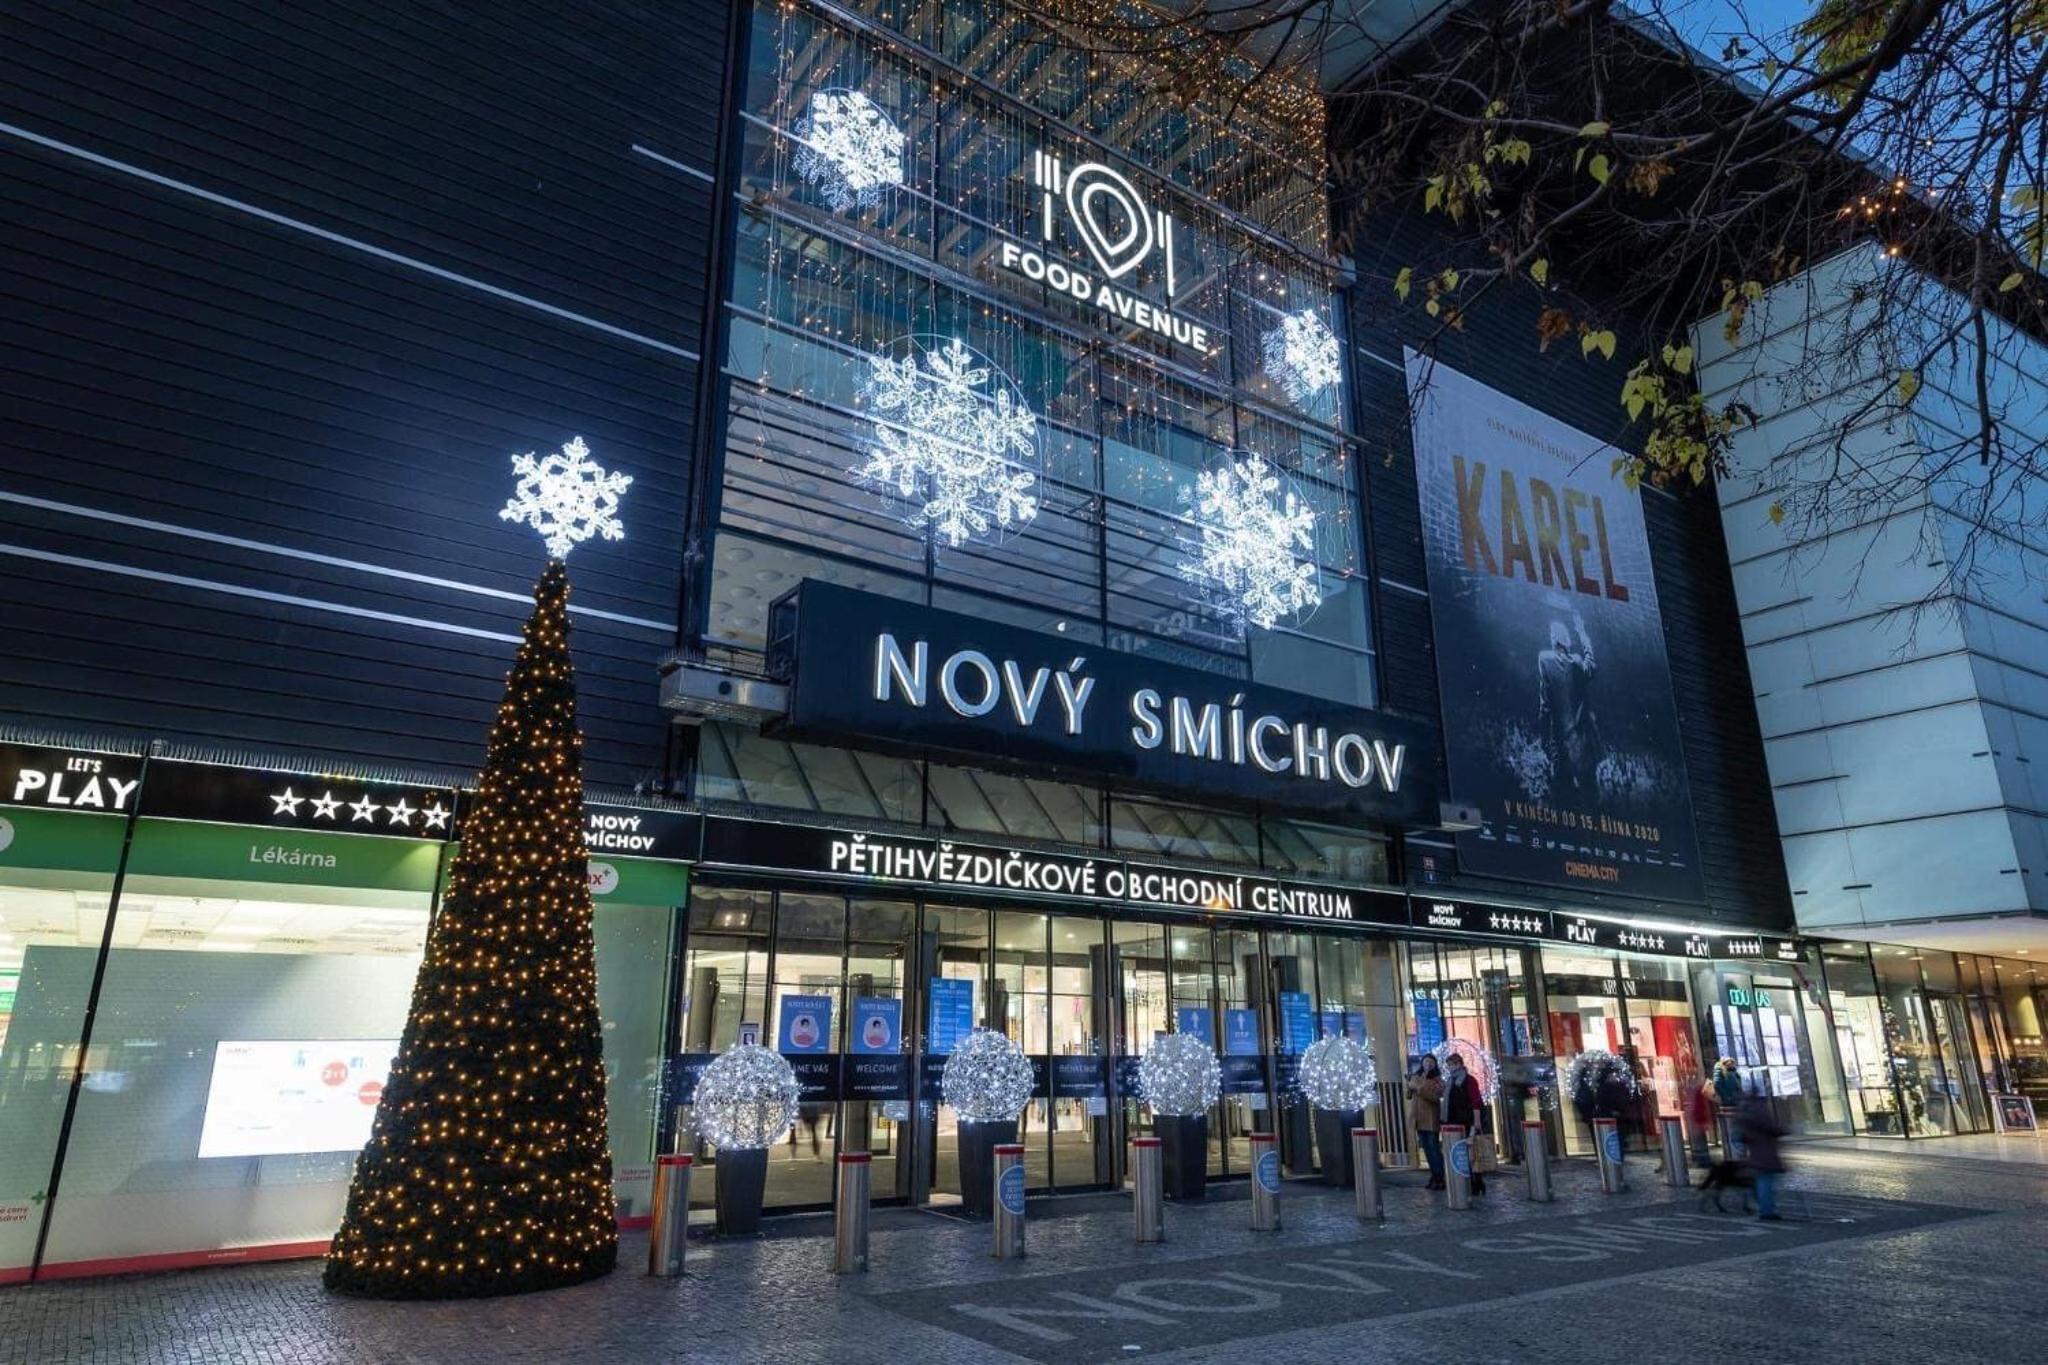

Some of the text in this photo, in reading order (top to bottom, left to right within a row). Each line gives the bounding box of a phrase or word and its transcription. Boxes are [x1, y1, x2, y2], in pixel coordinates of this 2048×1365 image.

[1003, 242, 1208, 352] FOOD AVENUE
[1453, 455, 1630, 602] KAREL
[874, 633, 1406, 793] NOVÝ SMÍCHOV
[67, 757, 103, 773] LET'S
[13, 769, 140, 809] PLAY
[590, 814, 642, 832] NOVÝ
[582, 829, 656, 851] MÍCHOV
[249, 845, 337, 868] Lékárna
[830, 833, 1353, 920] PĚTIHVĚZDIČKOVÉ OBCHODNÍ CENTRUM
[1566, 924, 1596, 943] PLAY
[1685, 940, 1709, 957] PLAY
[856, 1064, 898, 1074] WELCOME
